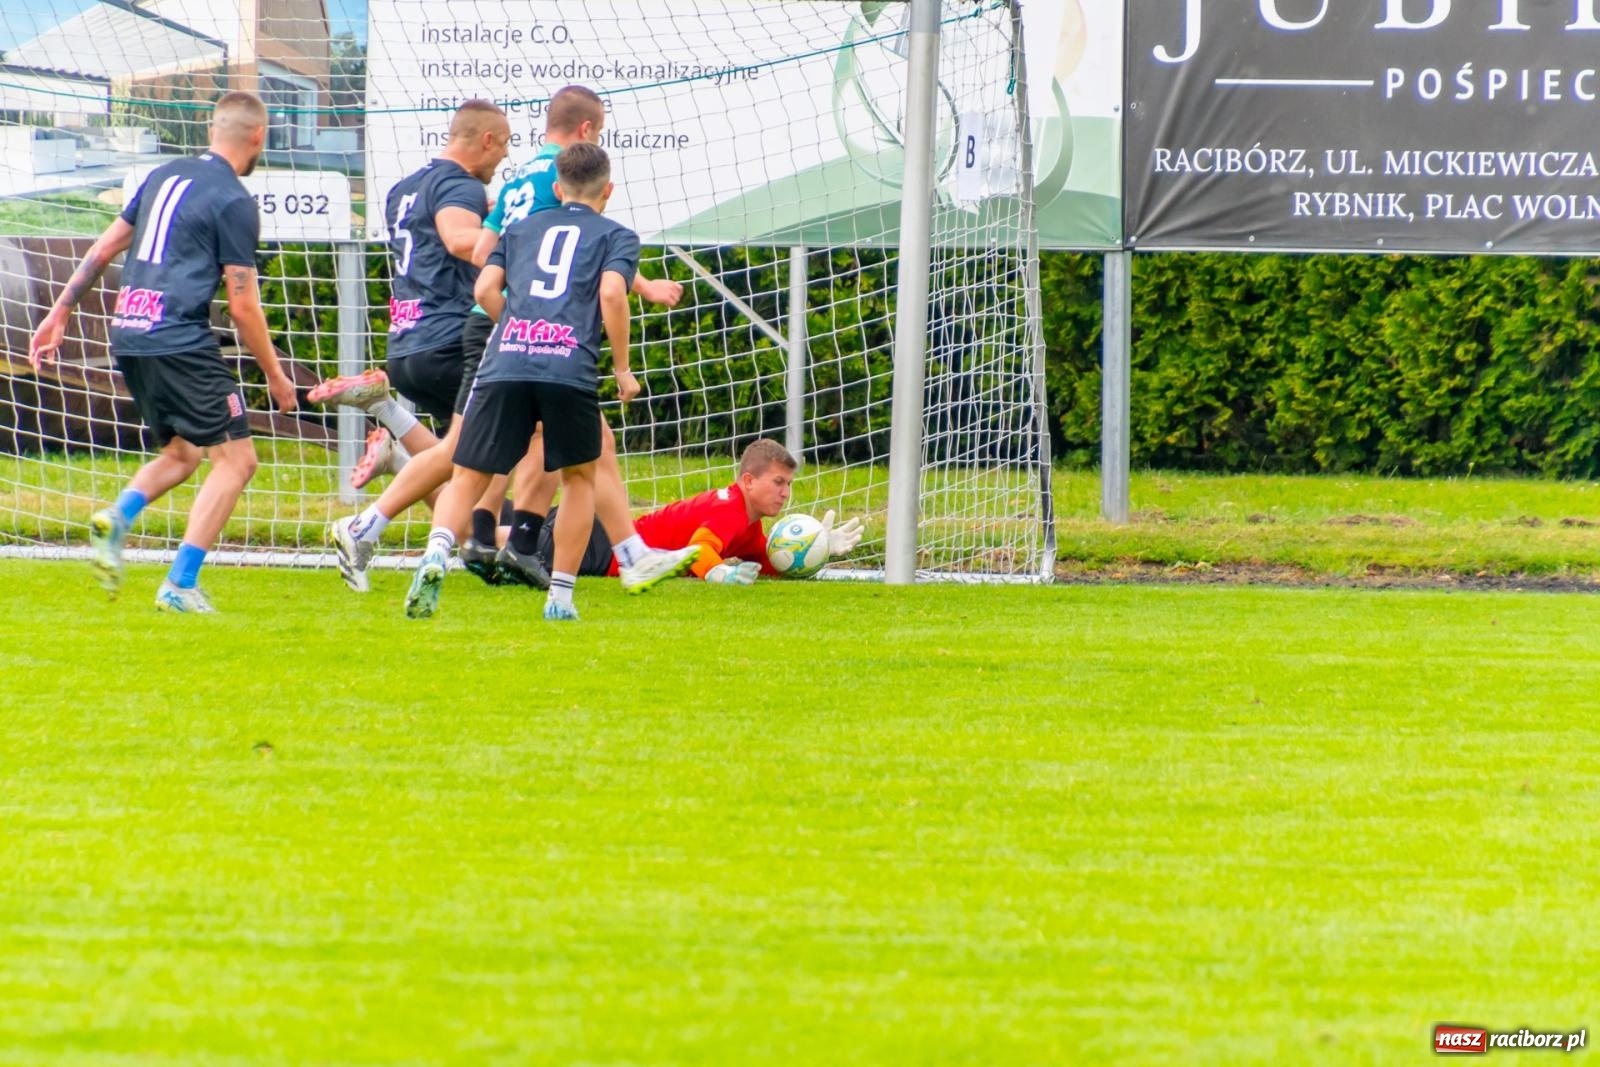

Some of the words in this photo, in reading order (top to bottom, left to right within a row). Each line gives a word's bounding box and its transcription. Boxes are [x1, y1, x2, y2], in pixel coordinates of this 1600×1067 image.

[421, 23, 523, 49] instalacje
[530, 25, 574, 44] C.O.
[421, 58, 523, 83] instalacje
[531, 59, 759, 85] wodno-kanalizacyjne
[1386, 62, 1596, 100] POŚPIEC
[965, 135, 976, 169] B
[1153, 142, 1315, 178] RACIBÓRZ,
[1325, 149, 1374, 174] UL.
[1384, 150, 1600, 177] MICKIEWICZA
[136, 174, 193, 265] 11
[284, 194, 330, 215] 032
[1293, 191, 1415, 223] RYBNIK,
[1425, 193, 1504, 220] PLAC
[392, 191, 418, 277] 5
[529, 225, 581, 300] 9
[501, 316, 578, 349] MAX
